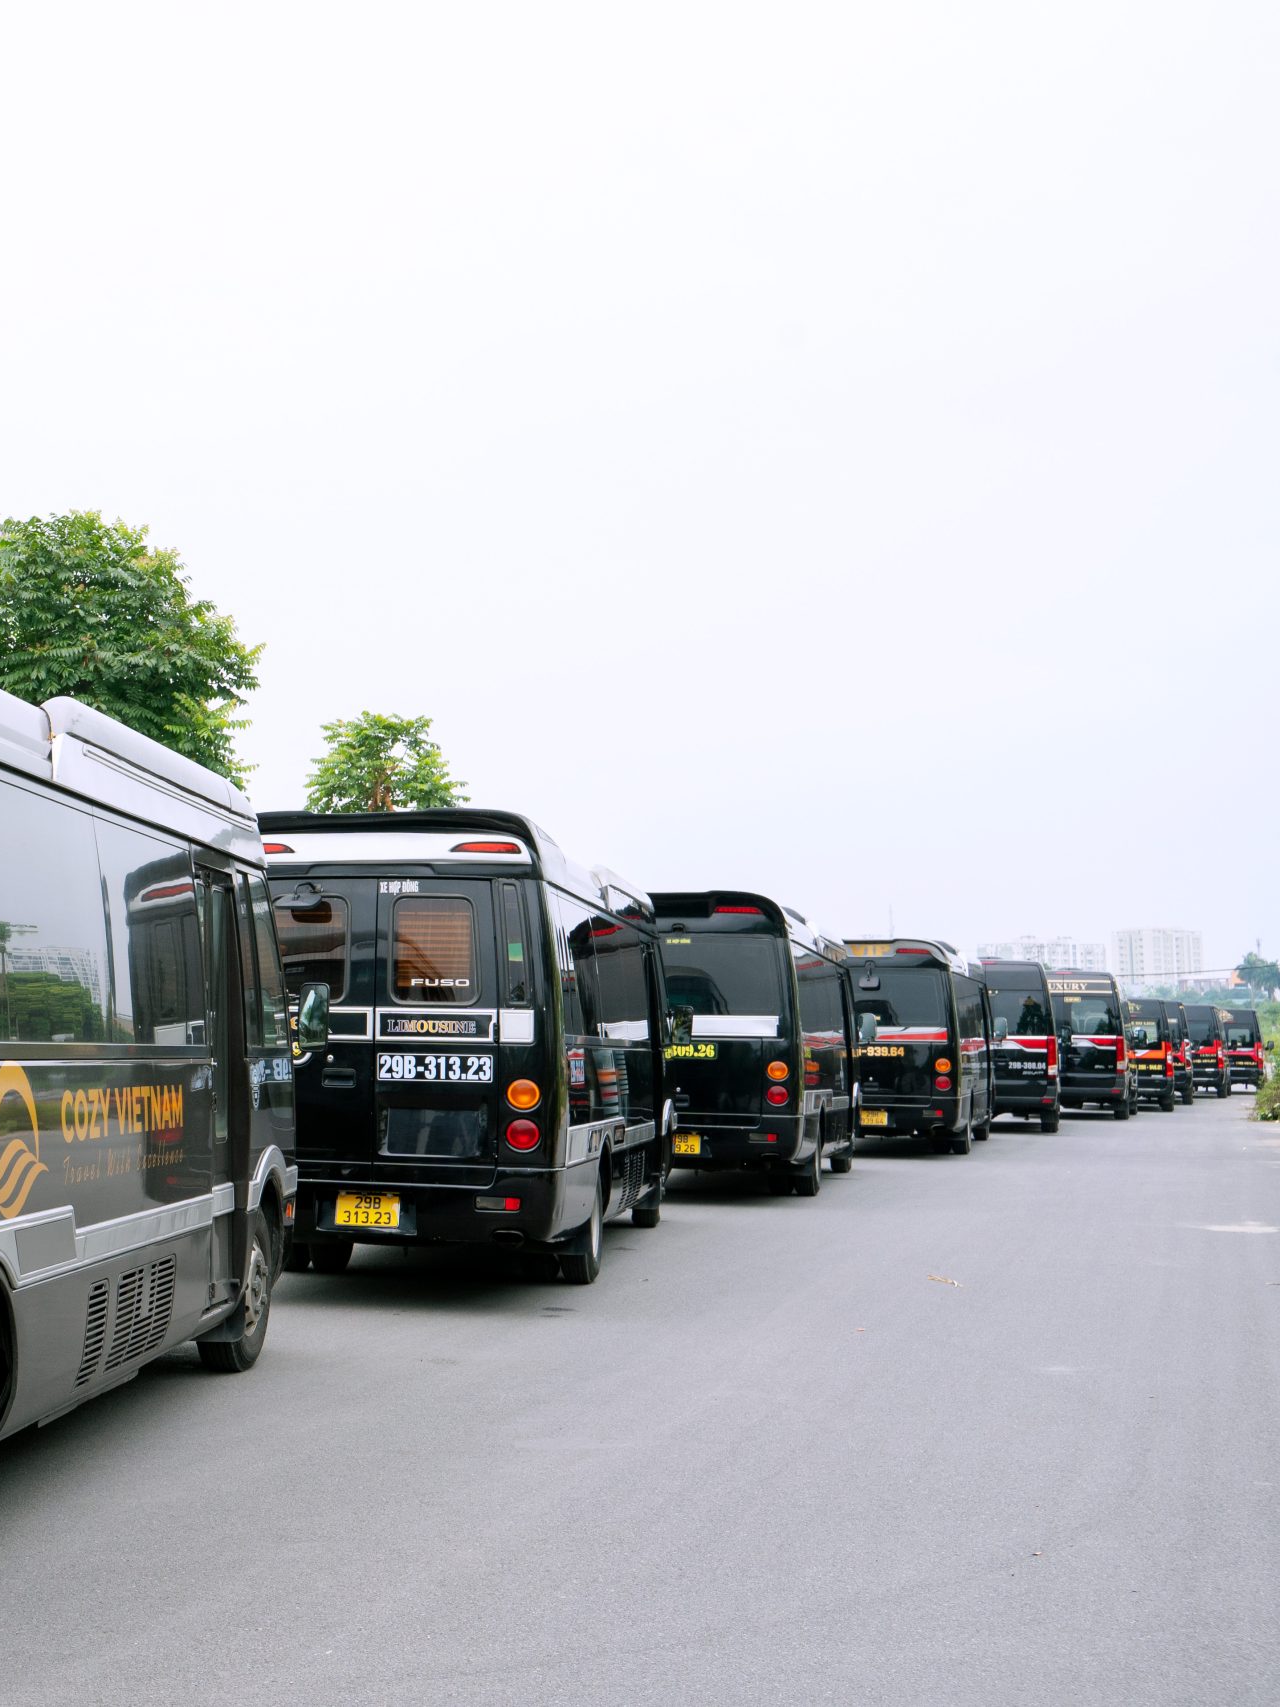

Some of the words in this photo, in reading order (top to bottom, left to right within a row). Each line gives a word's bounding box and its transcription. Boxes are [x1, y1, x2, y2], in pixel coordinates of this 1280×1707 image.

[851, 944, 890, 957] VIP
[411, 978, 470, 987] FUSO
[387, 1019, 477, 1034] LIMOUSINE
[379, 1055, 491, 1080] 29B-313.23
[61, 1088, 111, 1143] COZY
[114, 1084, 183, 1136] VIETNAM
[63, 1150, 101, 1185] Travel
[354, 1196, 382, 1209] 29B
[343, 1210, 392, 1225] 313.23
